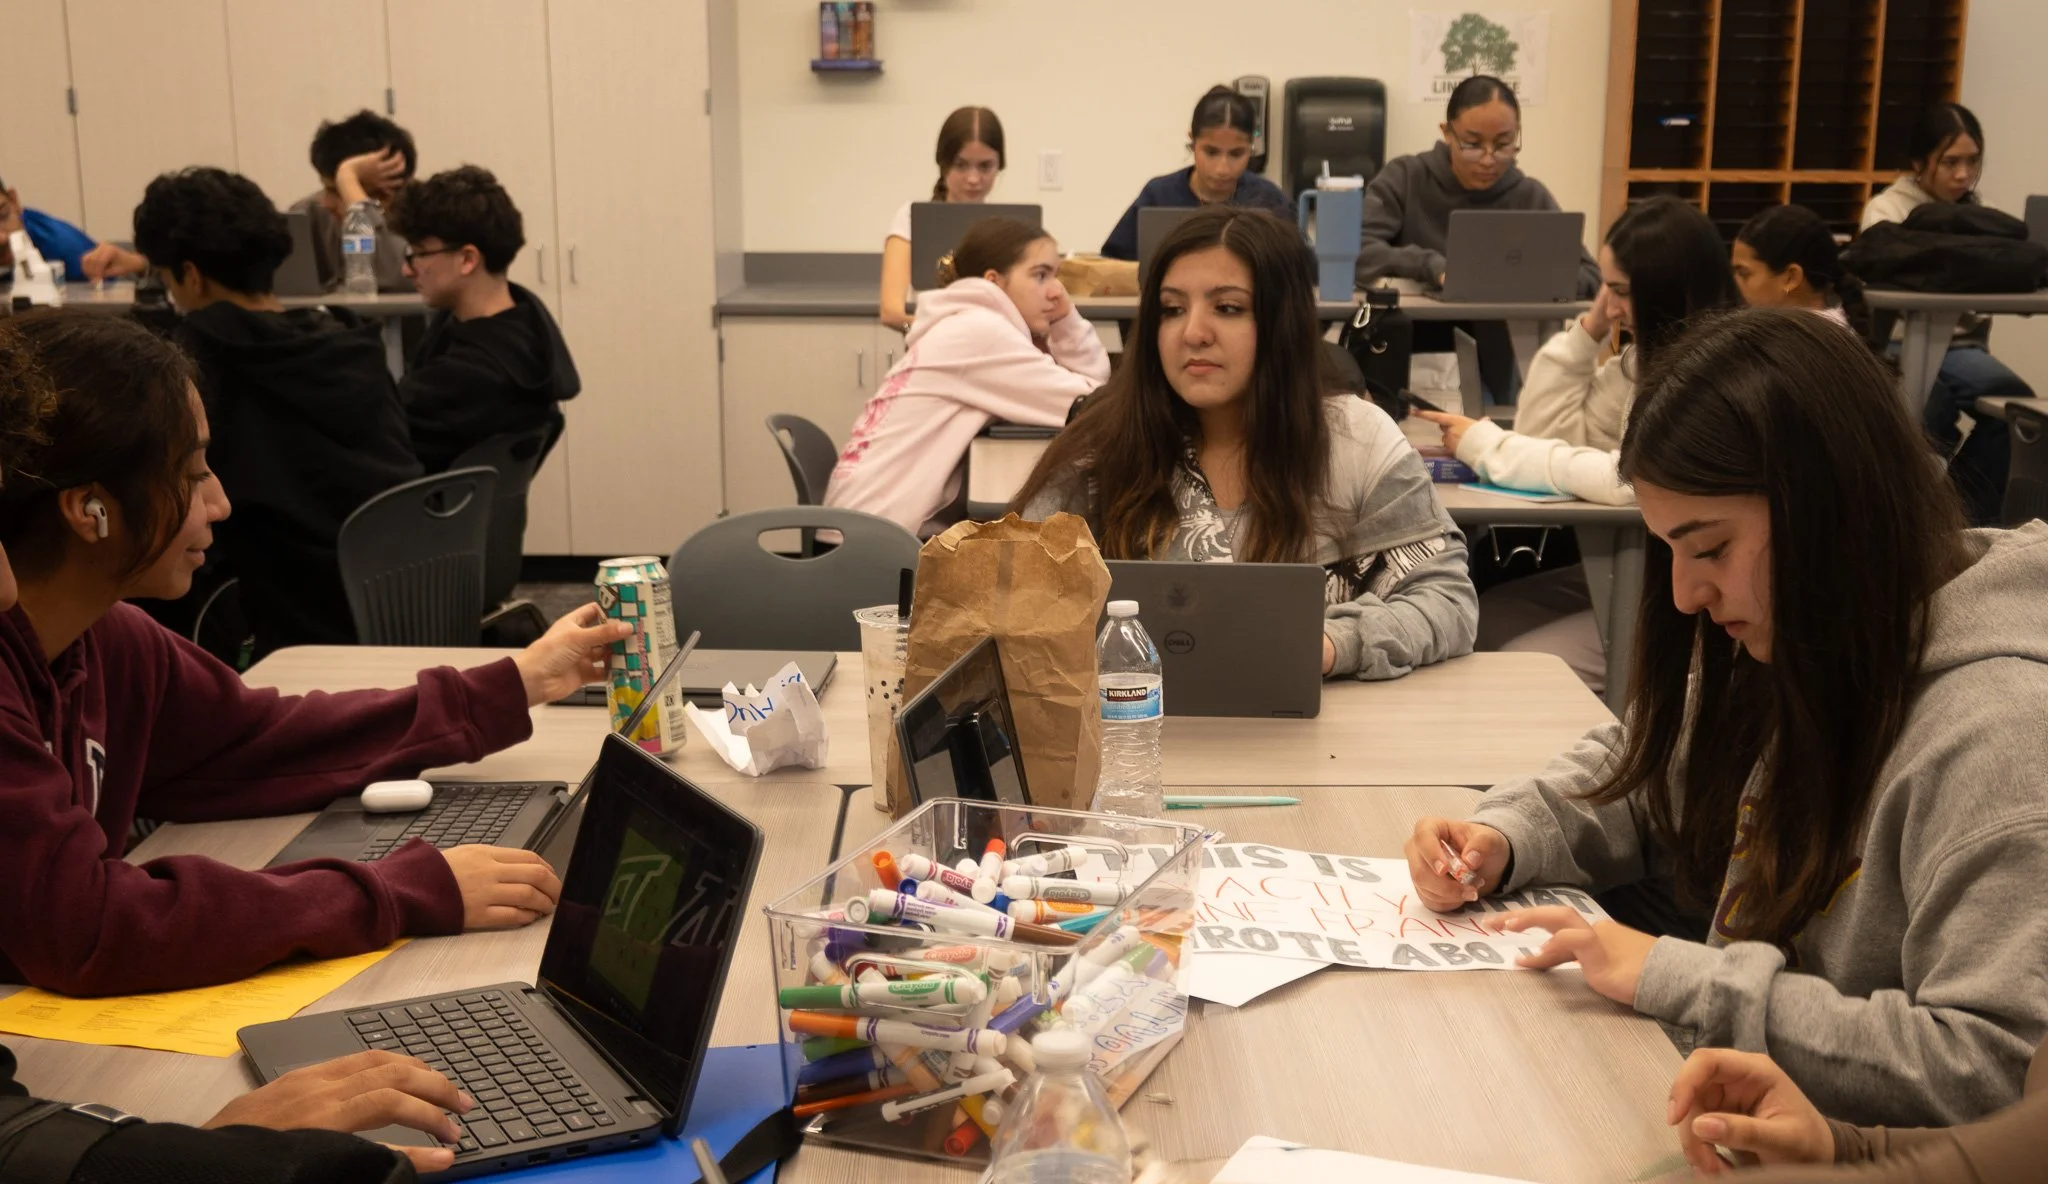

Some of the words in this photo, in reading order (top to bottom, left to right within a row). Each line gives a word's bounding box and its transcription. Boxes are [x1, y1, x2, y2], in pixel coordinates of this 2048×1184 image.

[1108, 689, 1147, 698] KIRKLAND
[1309, 853, 1382, 883] IS
[1047, 888, 1090, 900] Crayola
[1192, 925, 1369, 965] ROTE
[924, 946, 972, 961] Crayola
